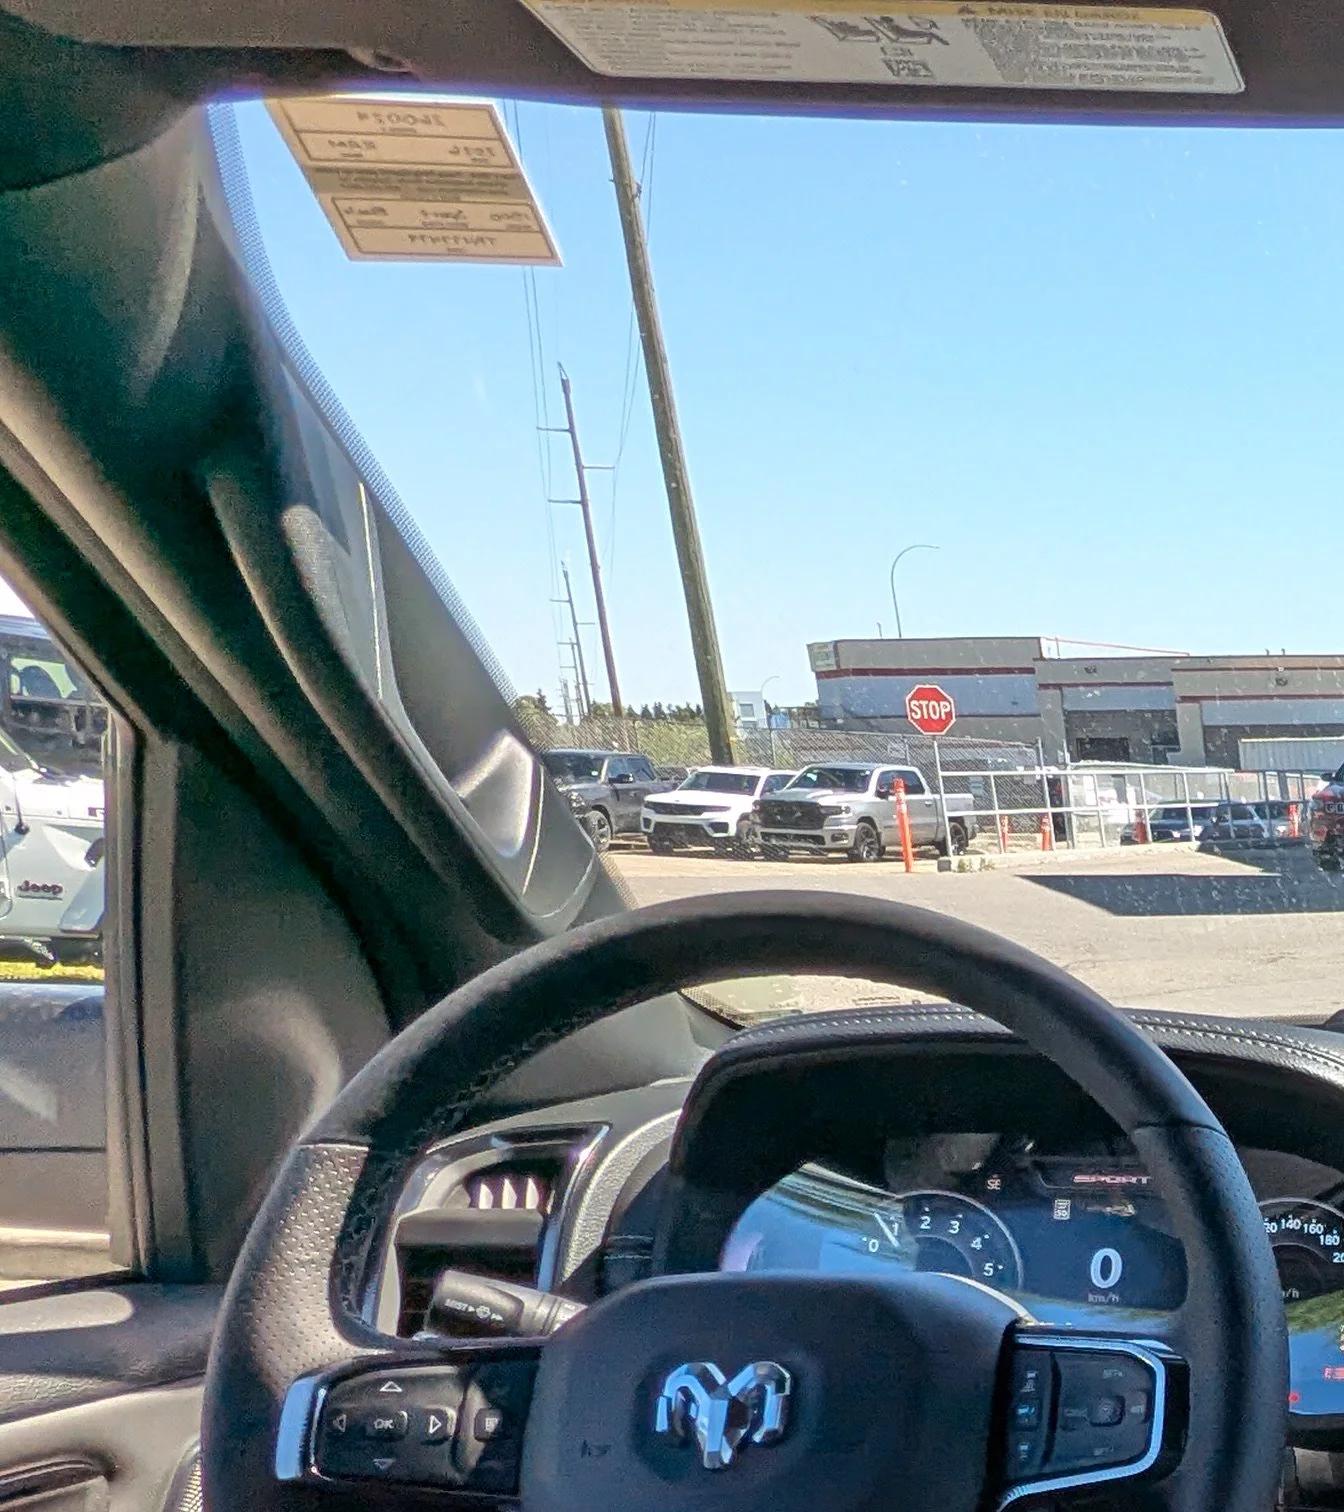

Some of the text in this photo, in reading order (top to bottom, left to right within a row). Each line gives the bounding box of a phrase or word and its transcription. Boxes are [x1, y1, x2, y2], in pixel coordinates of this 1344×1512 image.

[910, 700, 952, 721] STOP
[18, 880, 64, 895] Jeep
[920, 1216, 932, 1230] 2
[948, 1220, 960, 1234] 3
[1264, 1220, 1278, 1234] 20
[1280, 1218, 1302, 1231] 140
[1303, 1223, 1324, 1235] 160
[868, 1239, 880, 1252] 0
[970, 1236, 983, 1251] 4
[983, 1262, 994, 1277] 5
[1090, 1247, 1123, 1289] 0
[1087, 1291, 1120, 1304] km/h
[373, 1417, 395, 1431] OK
